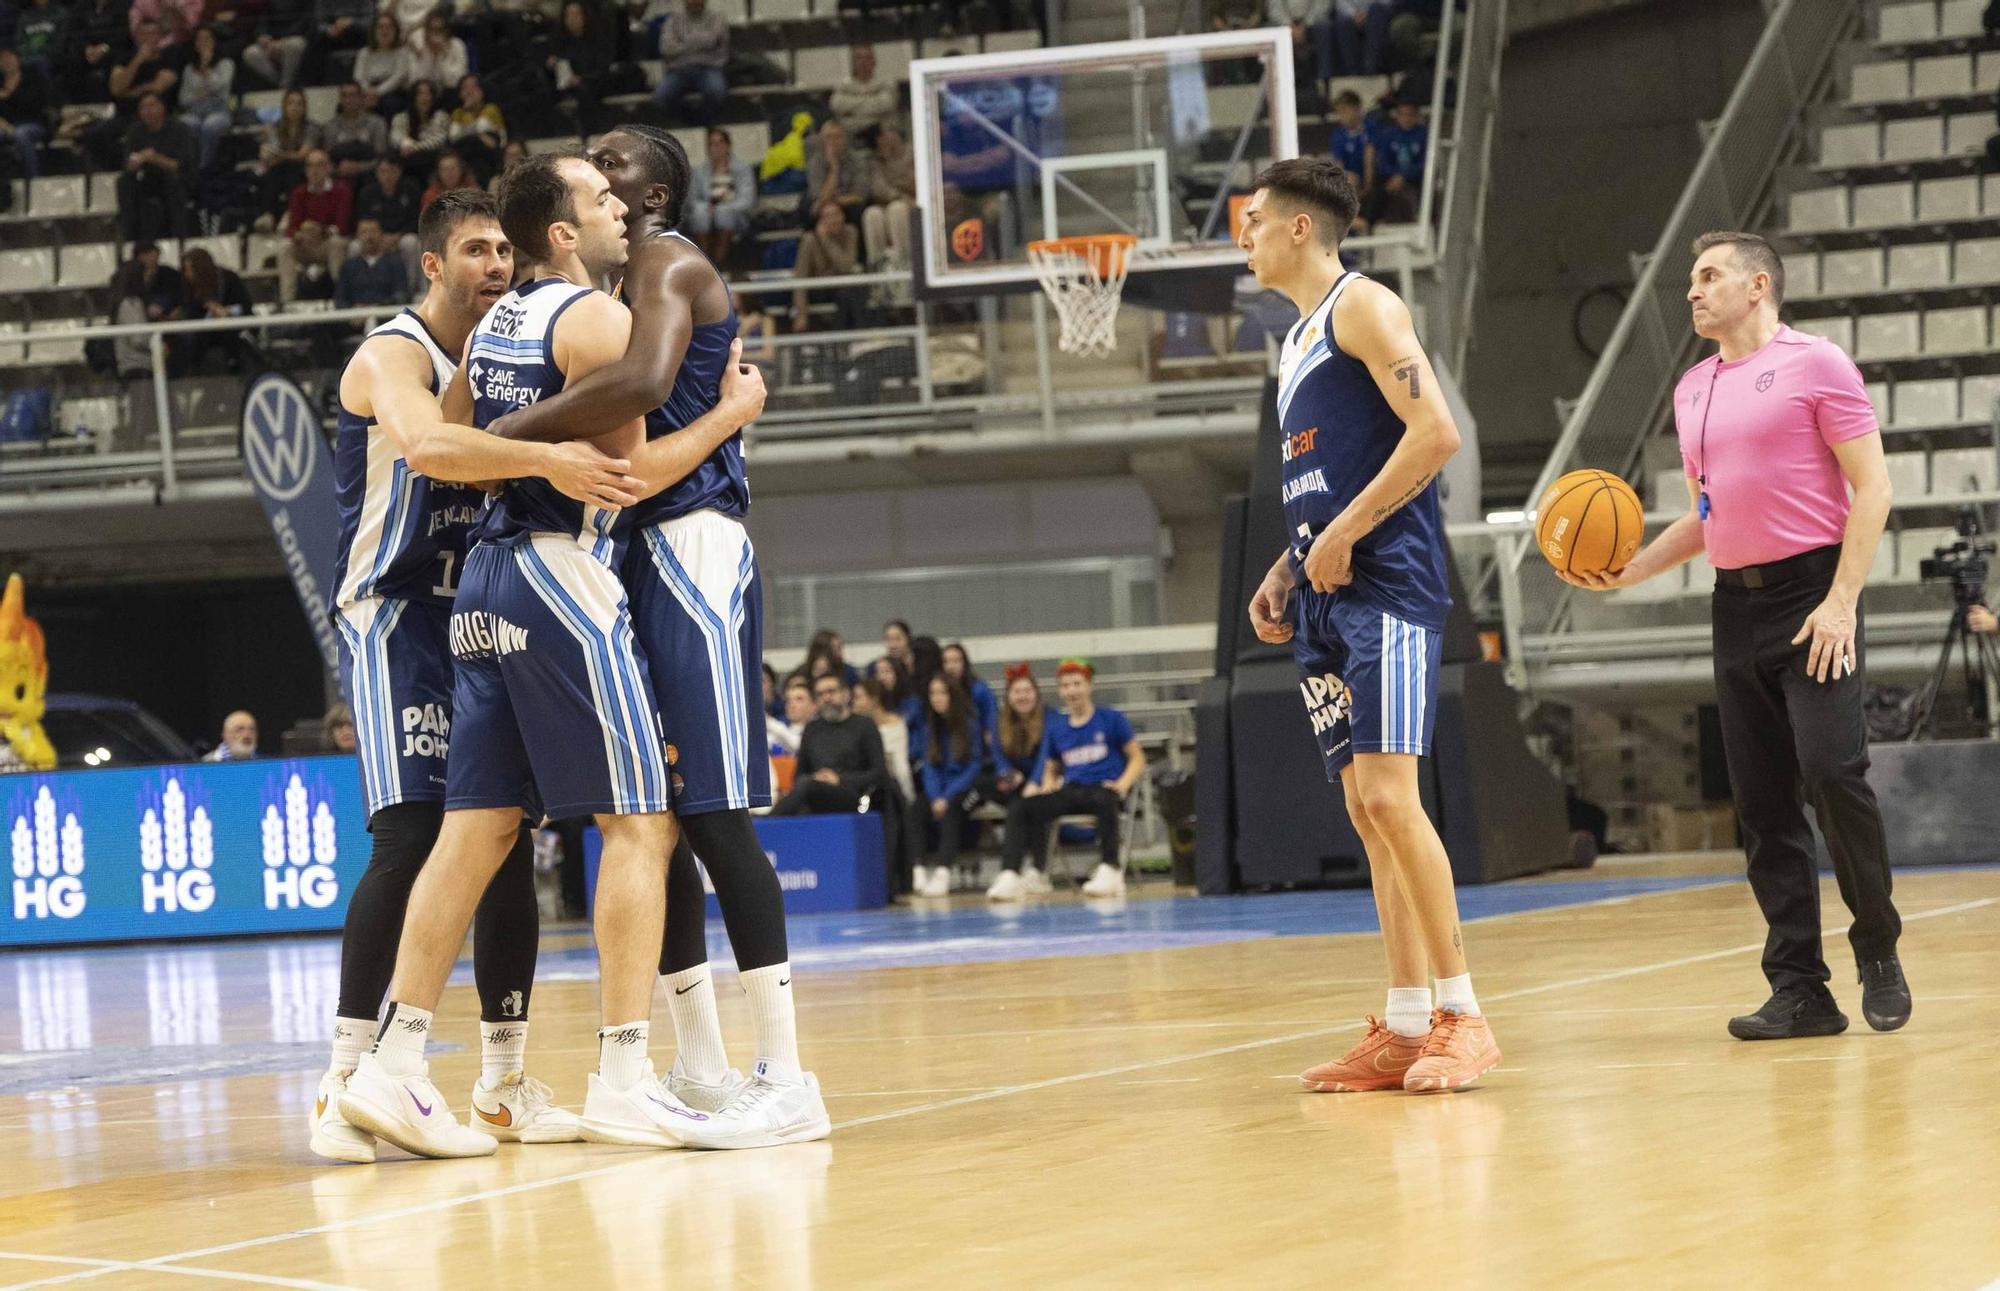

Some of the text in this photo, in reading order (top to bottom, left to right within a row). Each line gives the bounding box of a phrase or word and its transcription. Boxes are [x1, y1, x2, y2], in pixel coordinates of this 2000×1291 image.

[486, 367, 515, 386] SAVE
[486, 382, 542, 409] energy
[12, 875, 87, 919] HG
[142, 869, 216, 913] HG
[263, 865, 339, 910] HG
